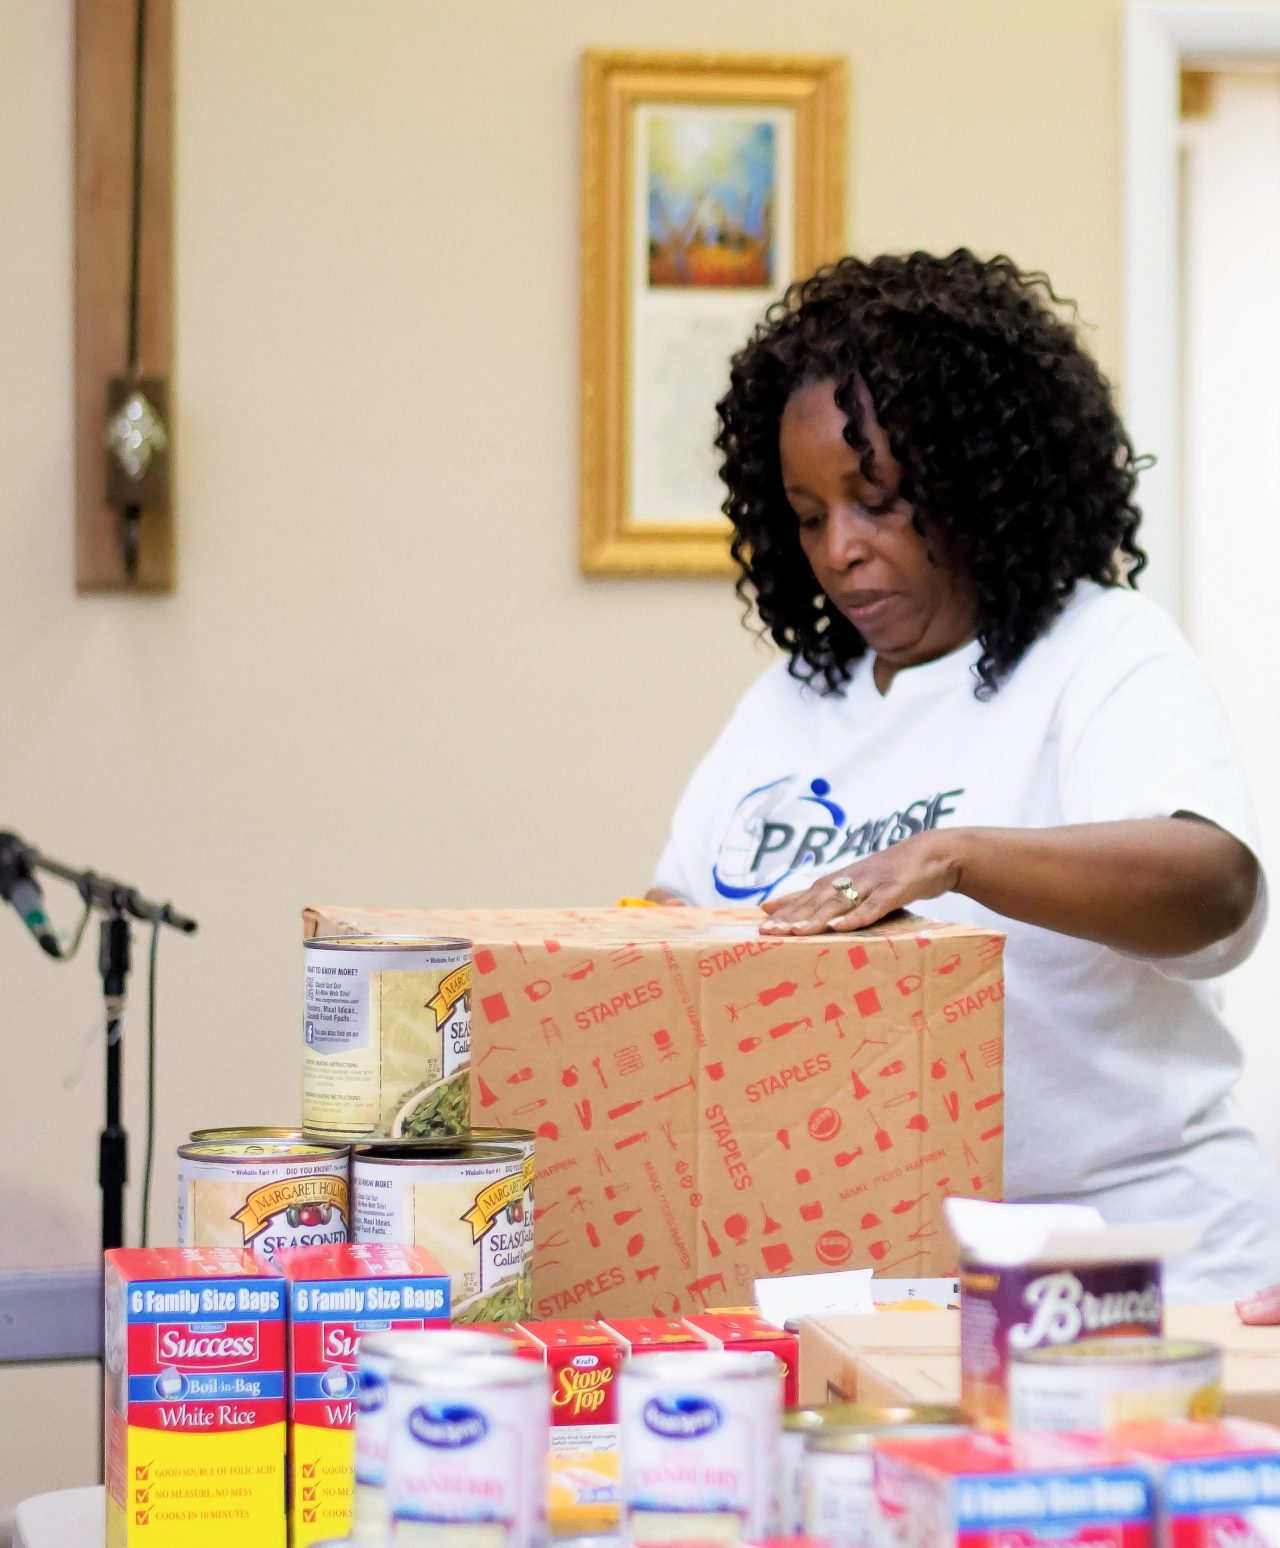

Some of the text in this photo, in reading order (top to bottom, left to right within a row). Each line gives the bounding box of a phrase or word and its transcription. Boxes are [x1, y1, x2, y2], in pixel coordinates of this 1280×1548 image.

[698, 940, 784, 977] STAPLE
[338, 968, 358, 976] MORE?
[574, 980, 663, 1030] STAPLES
[745, 1053, 832, 1102] STAPLES
[705, 1103, 752, 1191] STAPLES
[300, 1166, 312, 1174] YOU
[255, 1182, 317, 1211] MARGARET
[490, 1233, 523, 1252] SEASO
[132, 1288, 280, 1314] 6 Family Size Bags
[297, 1286, 444, 1313] 6 Family Size Bags
[538, 1266, 626, 1318] STAPLES
[160, 1330, 254, 1358] Success
[190, 1378, 261, 1396] Boil-in-Bag
[552, 1367, 614, 1406] Stove
[573, 1389, 606, 1415] Top
[159, 1403, 256, 1427] White Rice
[155, 1467, 181, 1478] GOOD
[182, 1466, 214, 1477] SOURCE
[216, 1467, 227, 1477] OF
[255, 1465, 276, 1476] ACID
[322, 1466, 347, 1476] GOOD
[155, 1490, 169, 1499] NO
[215, 1488, 230, 1497] NO
[231, 1487, 253, 1497] MESS
[322, 1487, 336, 1497] NO
[155, 1509, 250, 1521] COOKS IN 10 MINUTES
[323, 1509, 352, 1519] COOKS
